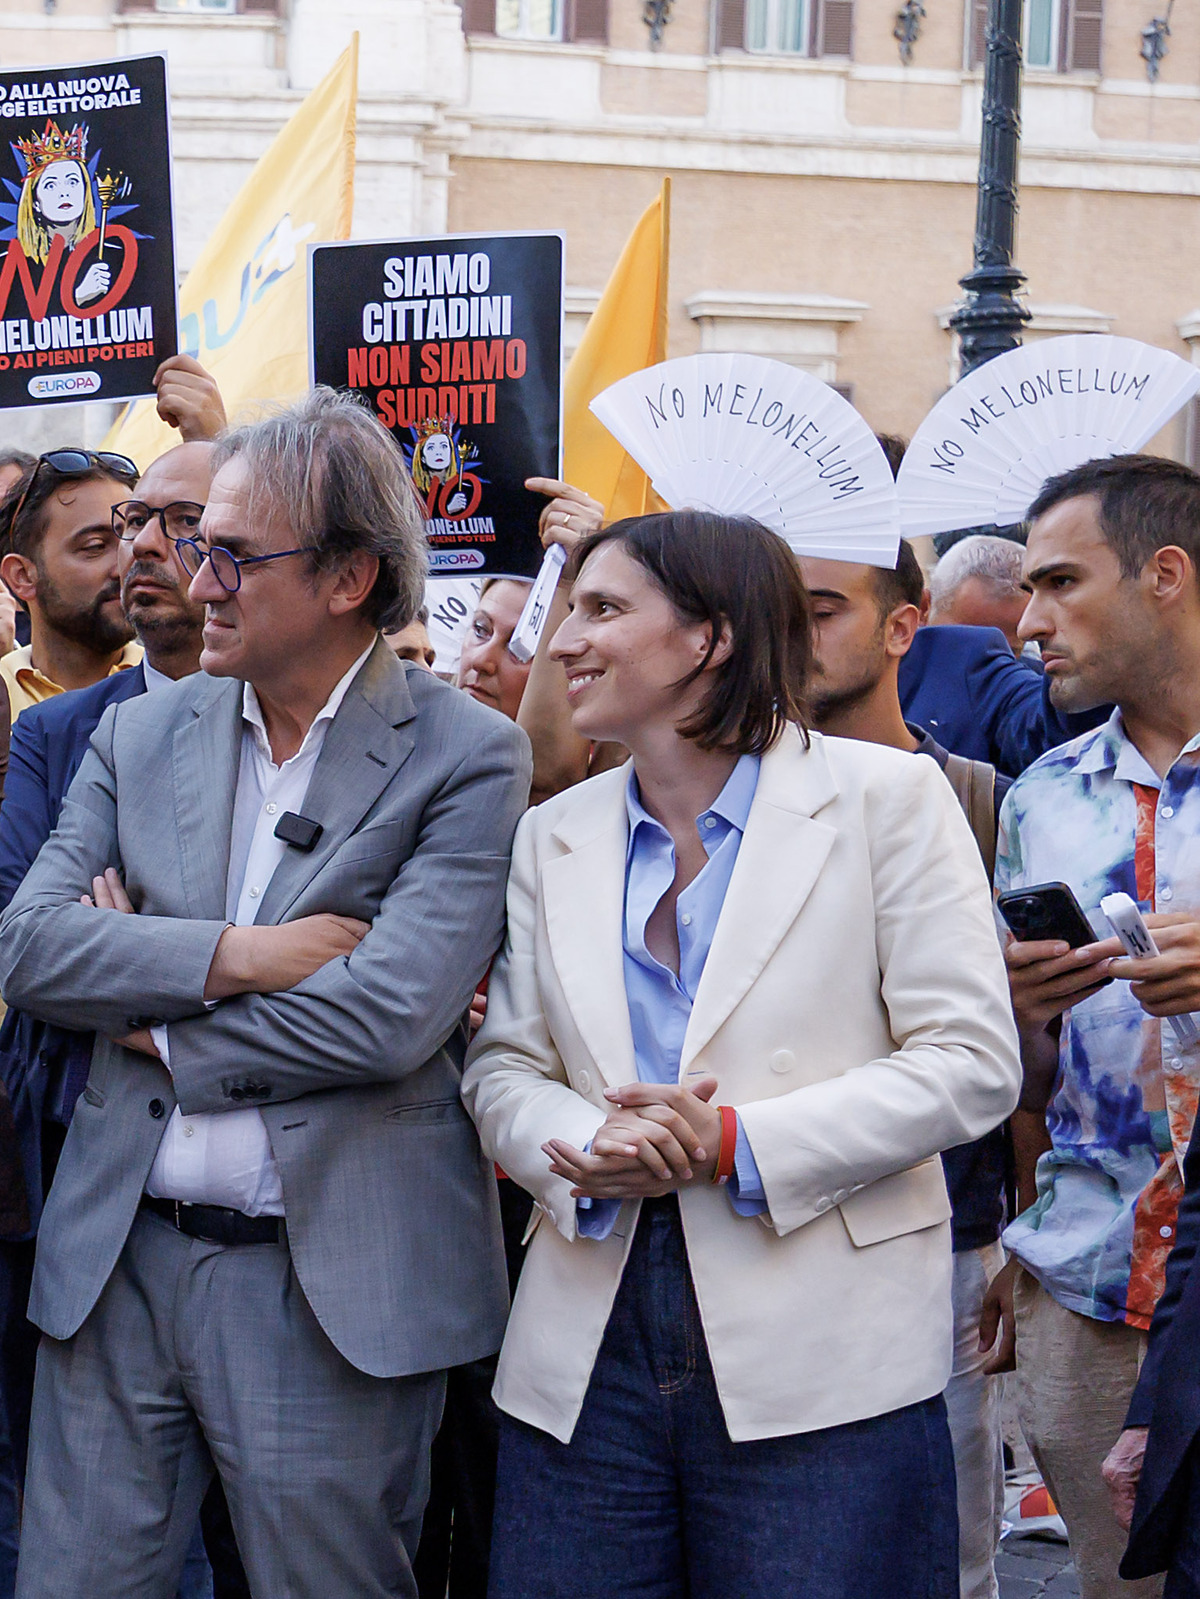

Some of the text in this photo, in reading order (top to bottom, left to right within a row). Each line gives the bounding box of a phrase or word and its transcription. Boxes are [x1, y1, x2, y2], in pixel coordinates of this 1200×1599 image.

[9, 82, 56, 100] ALLA
[58, 74, 130, 97] NUOVA
[27, 88, 141, 117] ELETTORALE
[383, 252, 491, 299] SIAMO
[362, 295, 512, 344] CITTADINI
[13, 353, 34, 369] AI
[36, 348, 85, 367] PIENI
[87, 341, 154, 363] POTERI
[348, 338, 527, 388] NON SIAMO
[376, 383, 496, 429] SUDDITI
[645, 383, 864, 500] NO MELONELLUM
[930, 440, 964, 474] NO
[425, 516, 495, 535] ONELLUM
[457, 534, 496, 543] POTERI
[428, 553, 480, 565] UROPA
[432, 596, 468, 630] NO
